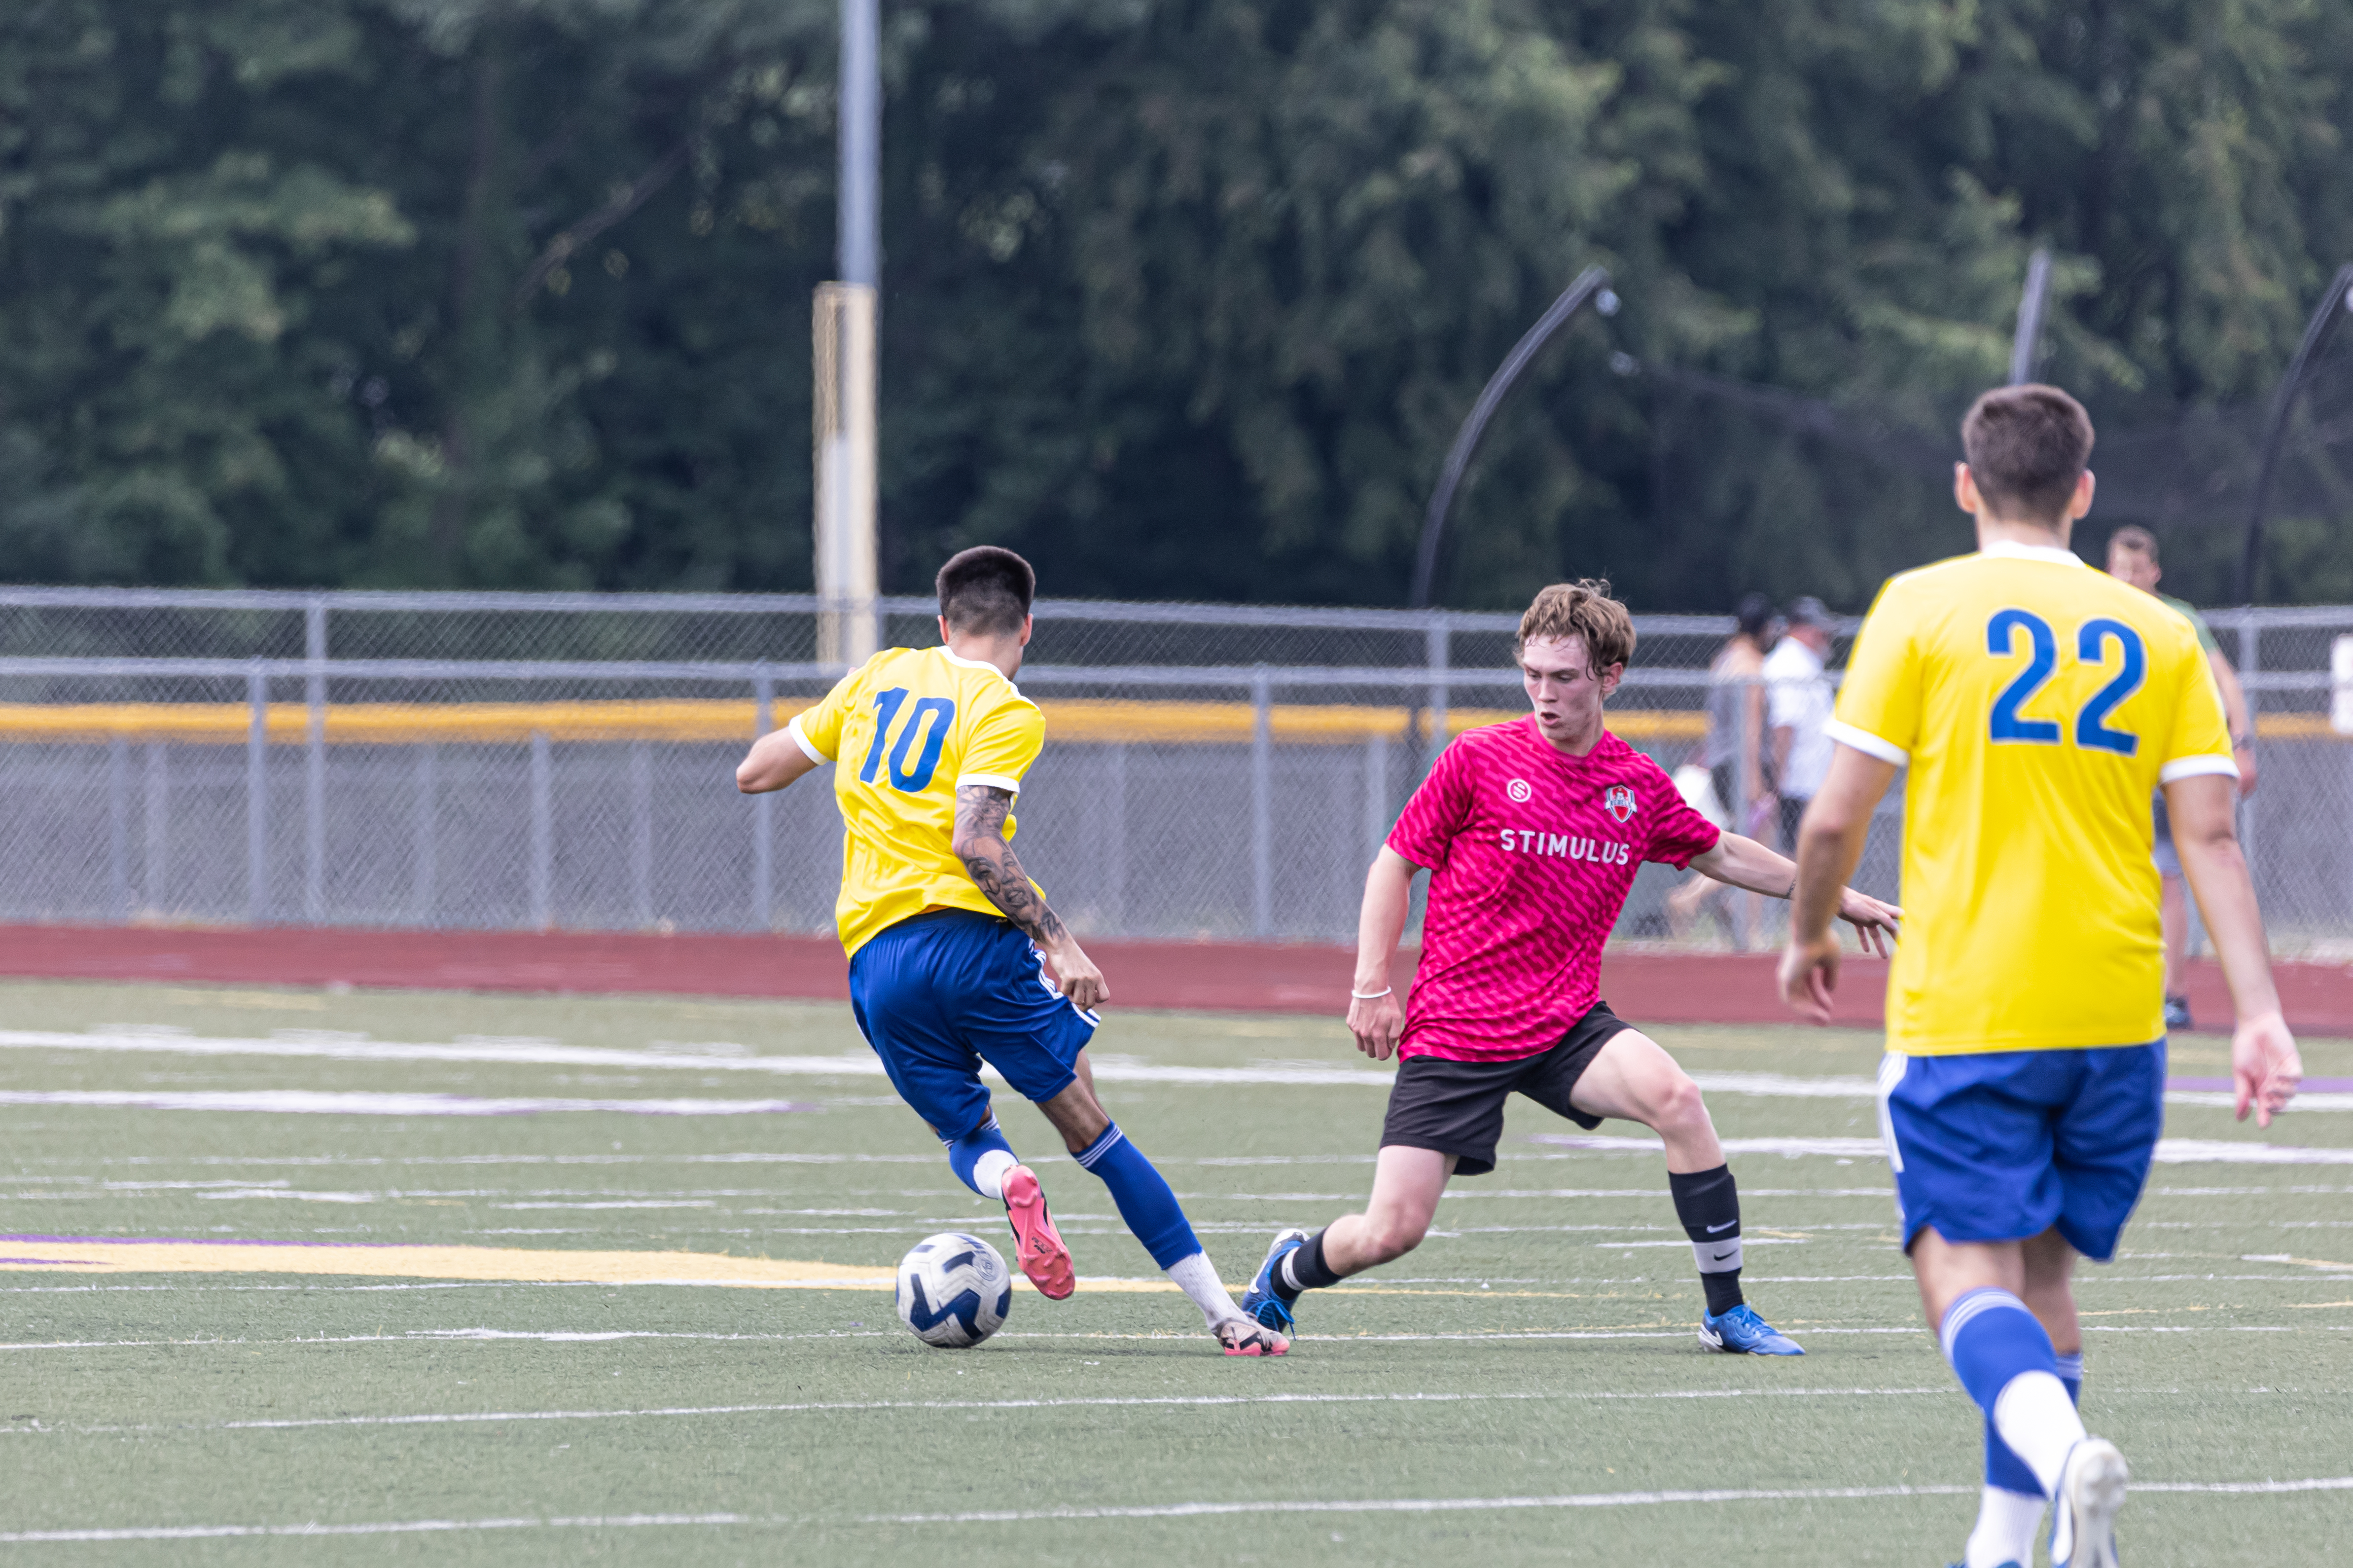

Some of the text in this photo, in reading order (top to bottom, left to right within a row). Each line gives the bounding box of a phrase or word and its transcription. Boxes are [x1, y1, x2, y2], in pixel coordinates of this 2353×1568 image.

[1986, 607, 2147, 757] 22
[860, 686, 955, 792] 10
[1500, 828, 1630, 865] STIMULUS
